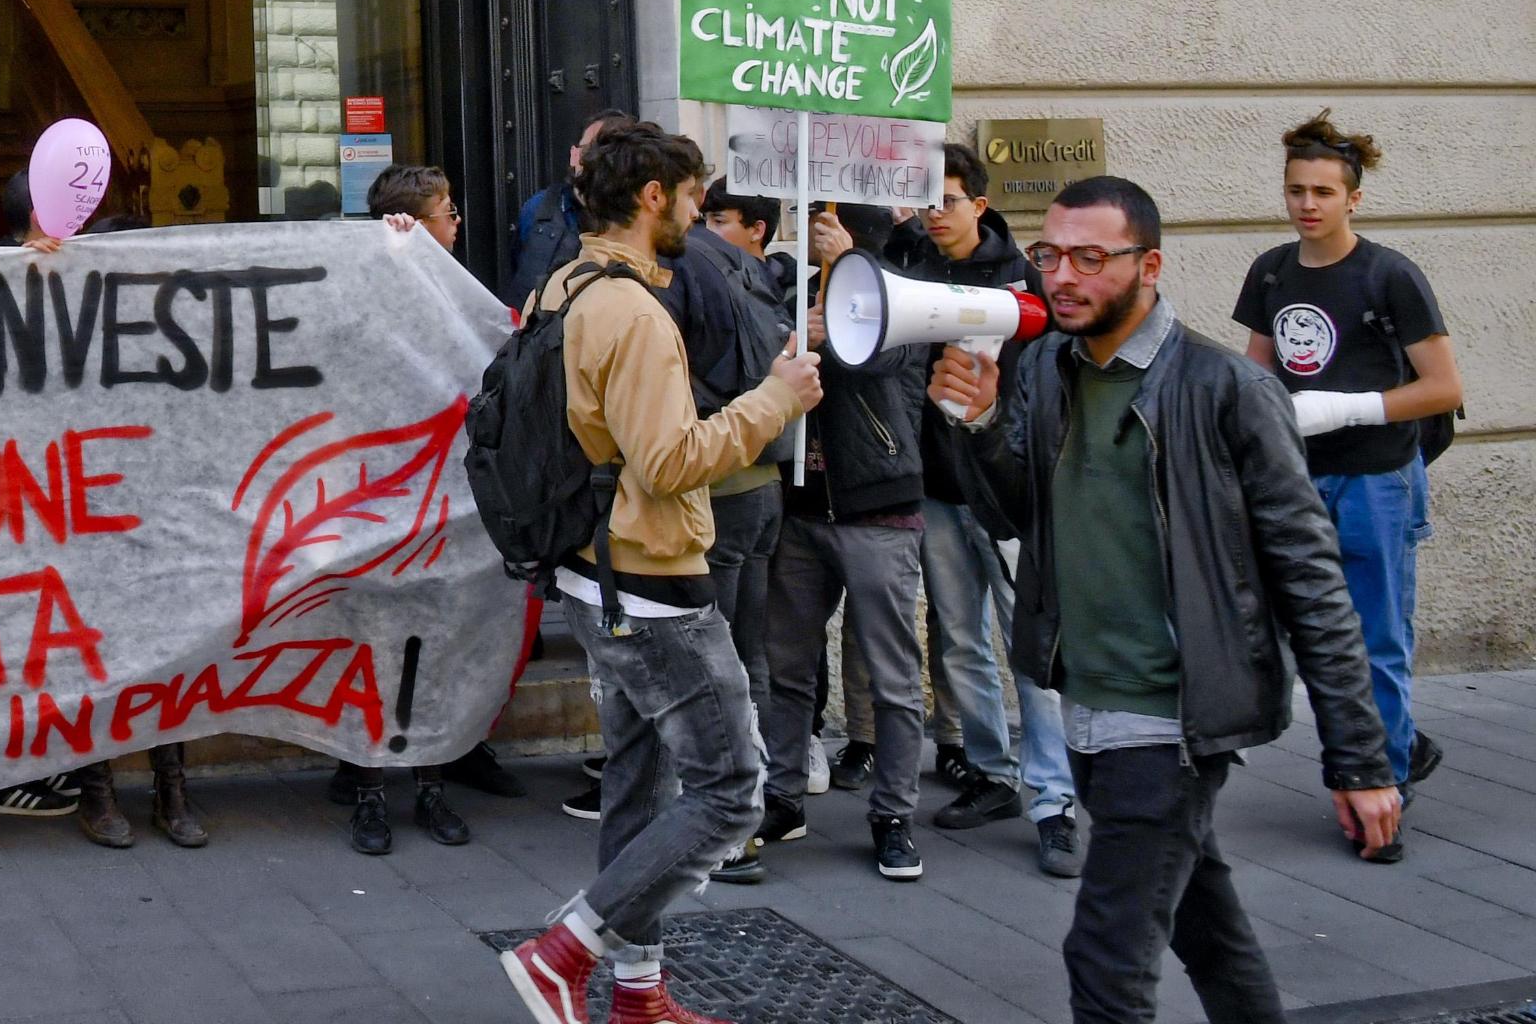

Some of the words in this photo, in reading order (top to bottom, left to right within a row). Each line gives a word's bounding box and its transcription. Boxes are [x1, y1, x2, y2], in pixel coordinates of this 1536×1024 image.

[691, 4, 852, 63] CLIMATE
[732, 60, 867, 102] CHANGE
[771, 121, 909, 161] COPEVOLE
[1009, 138, 1097, 163] UniCredit
[68, 161, 104, 192] 24
[757, 158, 834, 193] CLIMTE
[1003, 179, 1058, 194] DIREZIONE
[5, 692, 93, 759] IN
